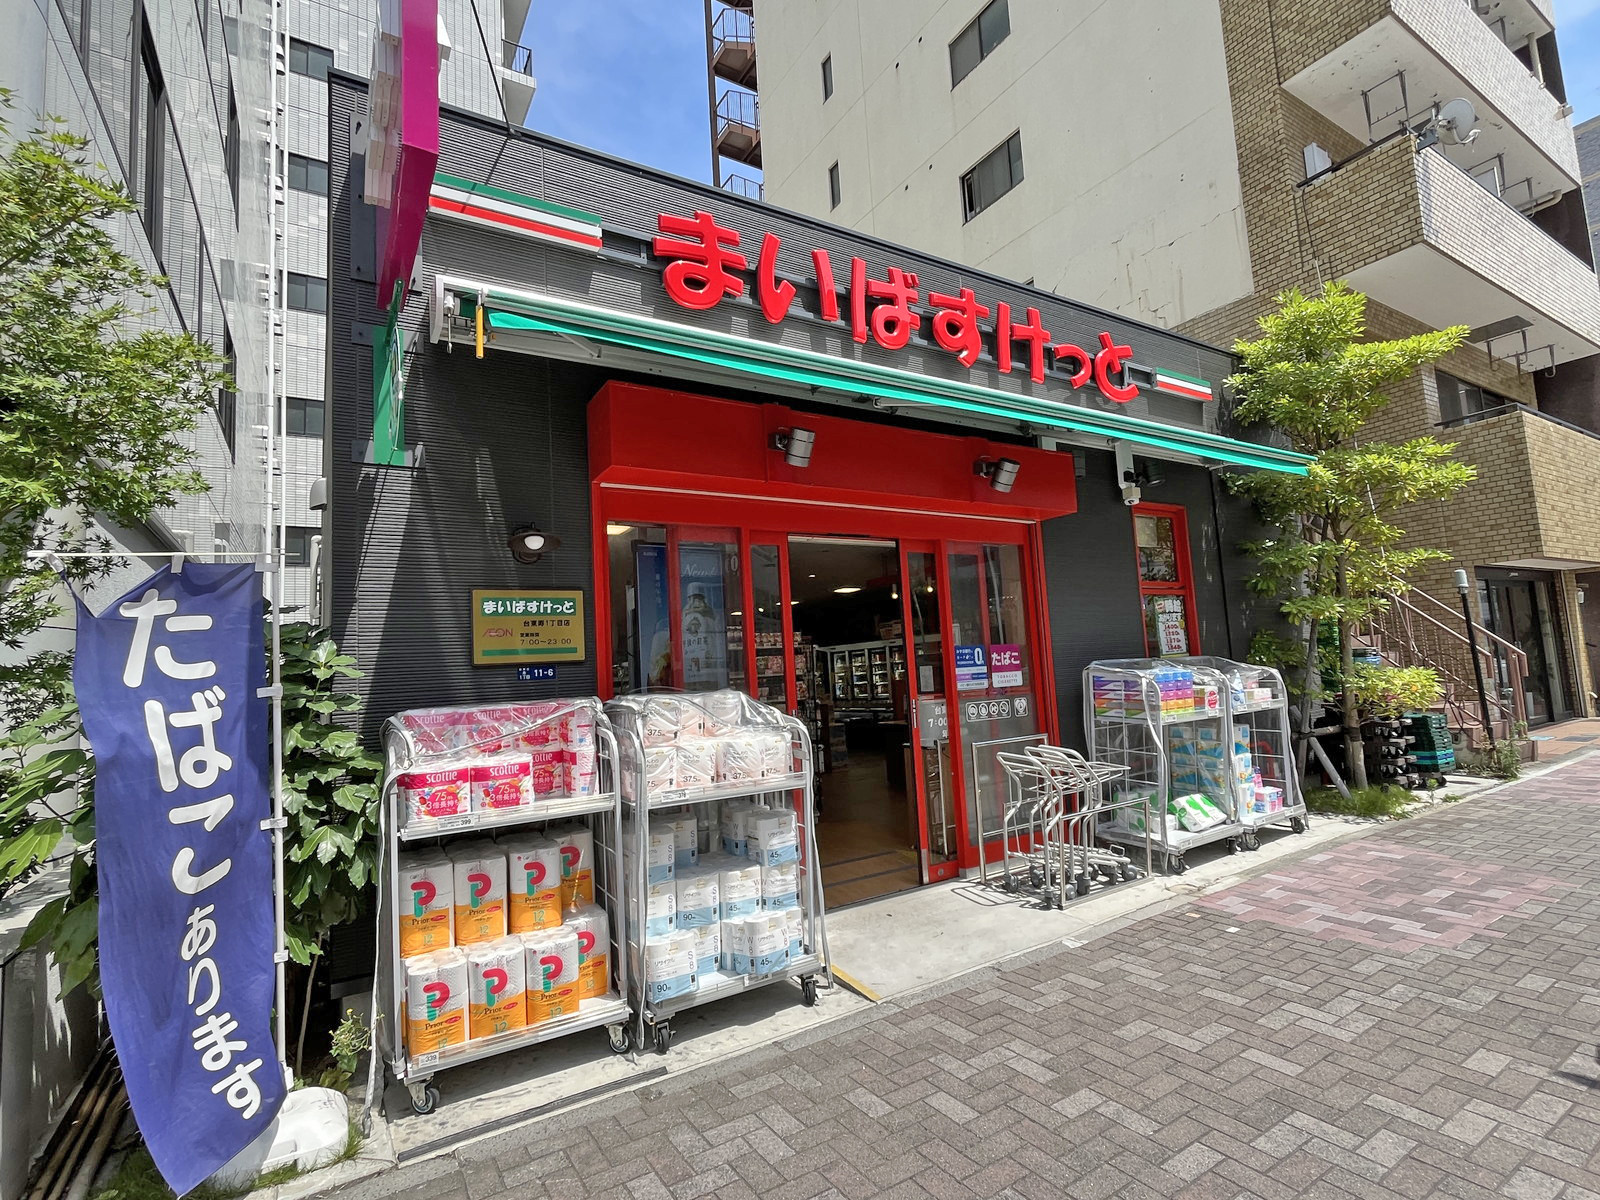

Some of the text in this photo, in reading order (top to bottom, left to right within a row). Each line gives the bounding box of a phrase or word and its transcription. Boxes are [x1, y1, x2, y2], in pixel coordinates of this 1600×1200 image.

[652, 210, 1140, 405] まいばすけっと
[483, 601, 574, 614] まいばすけっと
[483, 628, 513, 637] AEON
[991, 651, 1021, 666] たばこ
[534, 668, 554, 677] 11-6
[532, 752, 553, 763] cottie
[489, 763, 520, 777] scottie
[425, 770, 458, 784] scottie
[524, 896, 541, 904] Prior
[533, 909, 545, 923] 12
[411, 918, 430, 926] Prior
[540, 991, 558, 1001] Prior
[483, 1006, 502, 1015] Prior
[424, 1020, 444, 1031] Prior
[494, 1021, 508, 1034] 12
